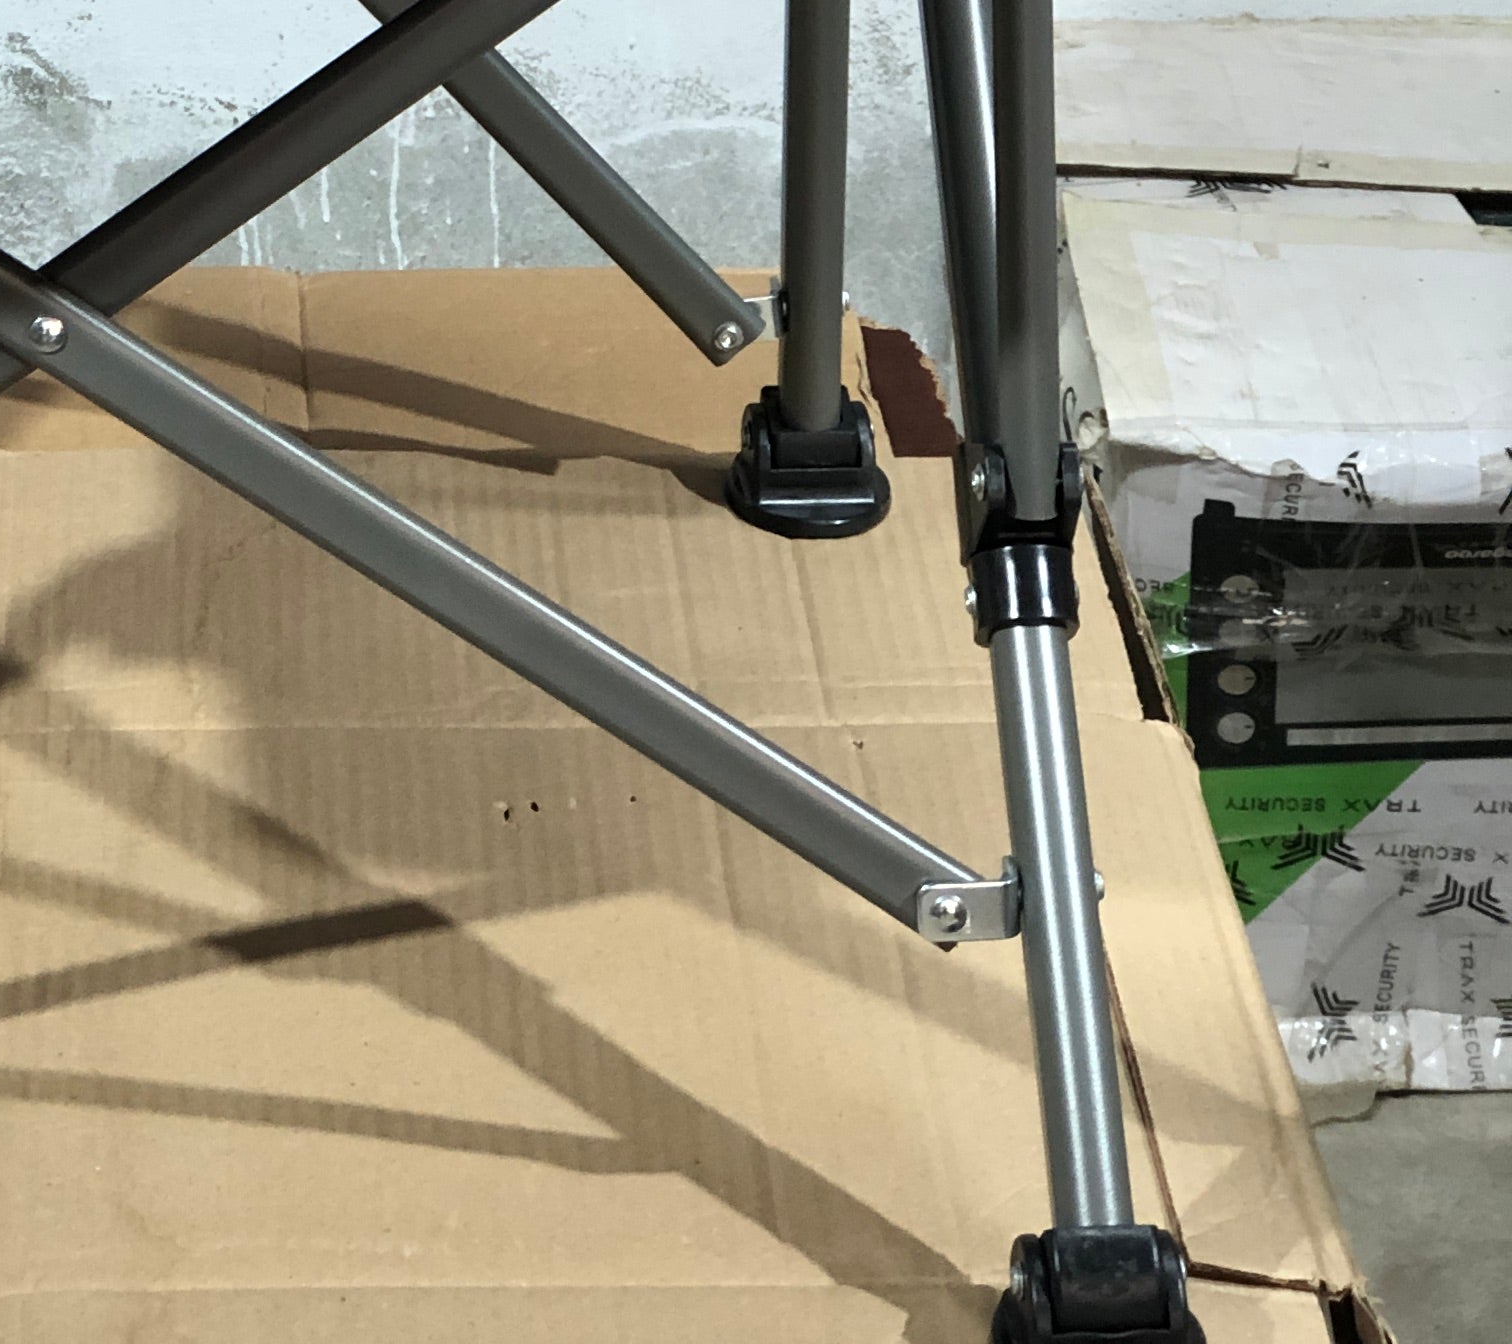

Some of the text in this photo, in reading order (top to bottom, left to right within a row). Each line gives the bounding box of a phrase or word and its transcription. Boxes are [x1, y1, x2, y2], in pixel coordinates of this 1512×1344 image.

[1225, 797, 1421, 813] TRAX SECURITY
[1374, 843, 1476, 862] SECURITY
[1372, 942, 1400, 1024] SECURITY
[1459, 941, 1476, 1004] TRAX
